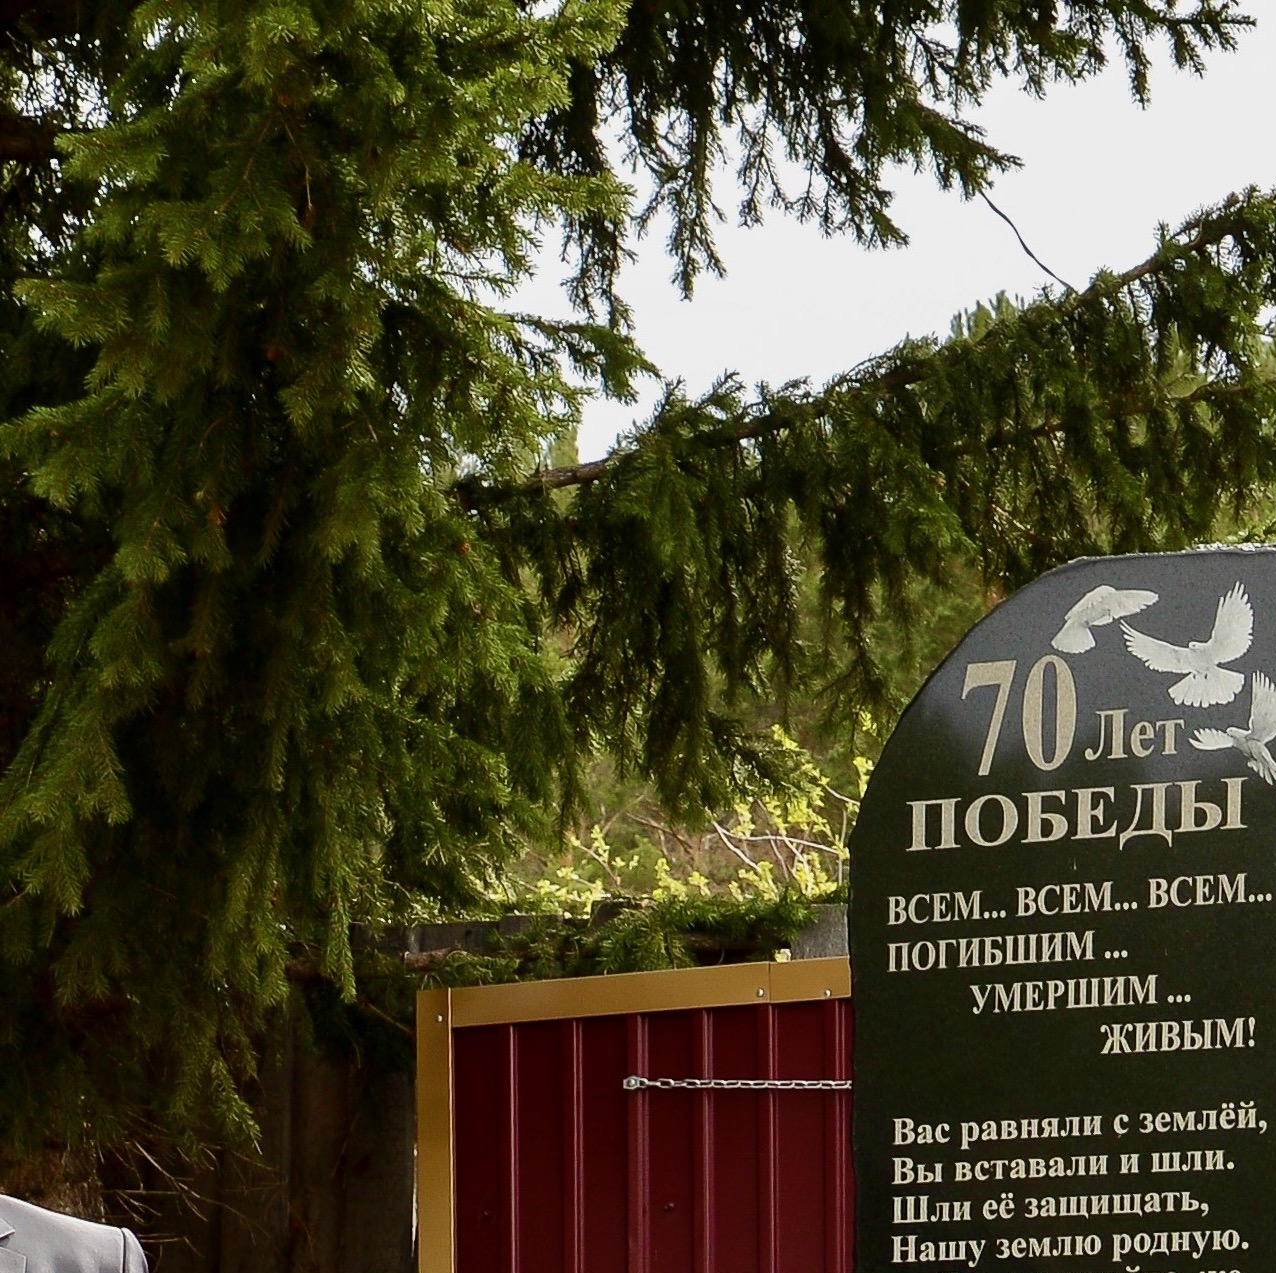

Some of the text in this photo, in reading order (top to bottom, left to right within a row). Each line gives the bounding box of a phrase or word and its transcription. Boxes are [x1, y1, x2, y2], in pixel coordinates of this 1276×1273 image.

[961, 653, 1186, 777] 70 Лет
[905, 776, 1249, 852] ПОБЕДЫ
[886, 872, 1273, 927] ВСЕМ... ВСЕМ... ВСЕМ...
[886, 929, 1096, 974] ПОГИБШИМ
[970, 974, 1158, 1016] УМЕРШИМ
[1100, 1016, 1256, 1053] ЖИВЫМ!
[892, 1100, 1269, 1151] Вас равняли с землёй,
[892, 1150, 1236, 1186] Вы вставали и шли.
[892, 1190, 1210, 1225] Шли её защищать,
[891, 1227, 1250, 1267] Нашу землю родную.
